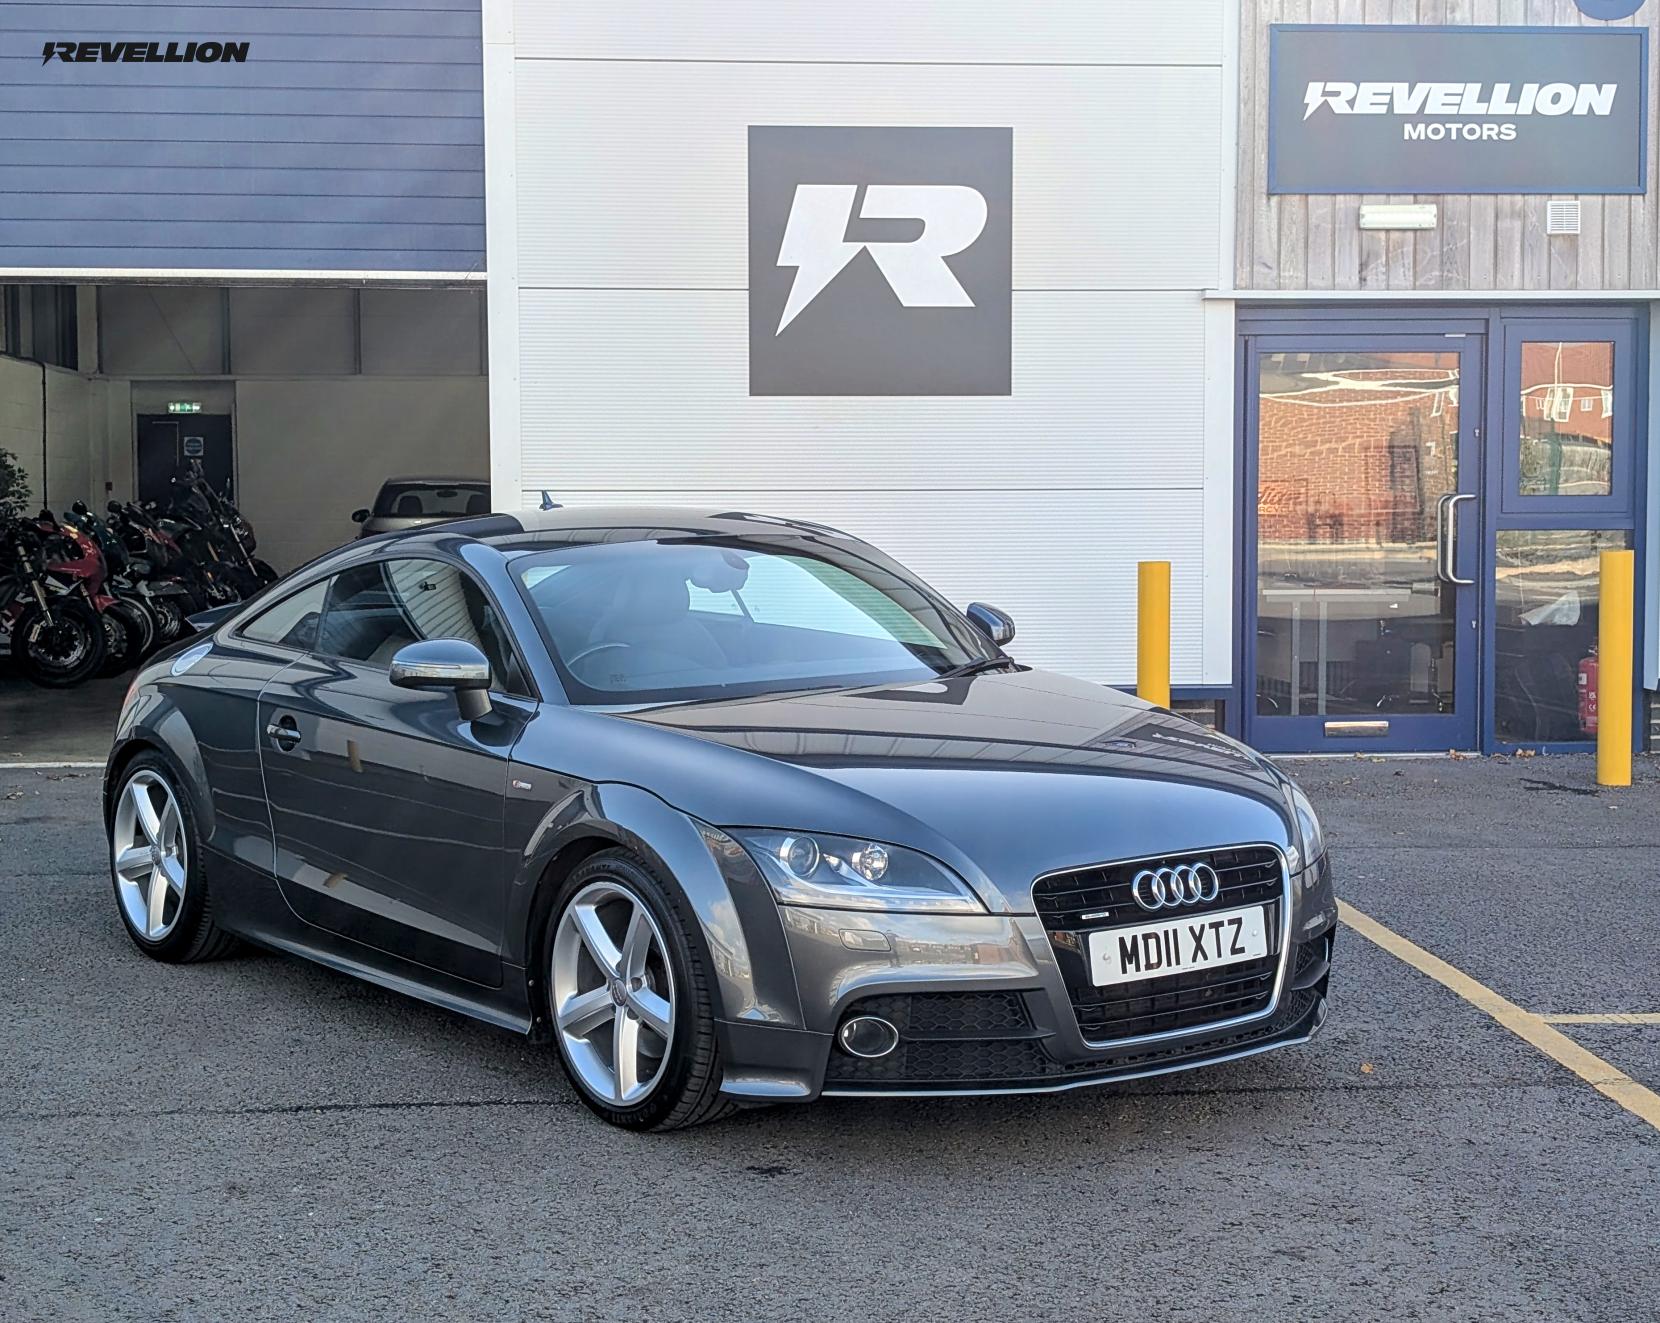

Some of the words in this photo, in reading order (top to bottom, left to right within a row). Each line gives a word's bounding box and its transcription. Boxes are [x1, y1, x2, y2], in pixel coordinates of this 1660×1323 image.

[1302, 81, 1617, 121] REVELLION
[1403, 122, 1517, 141] MOTORS
[1118, 928, 1181, 975] MD11
[1188, 917, 1246, 963] XTZ
